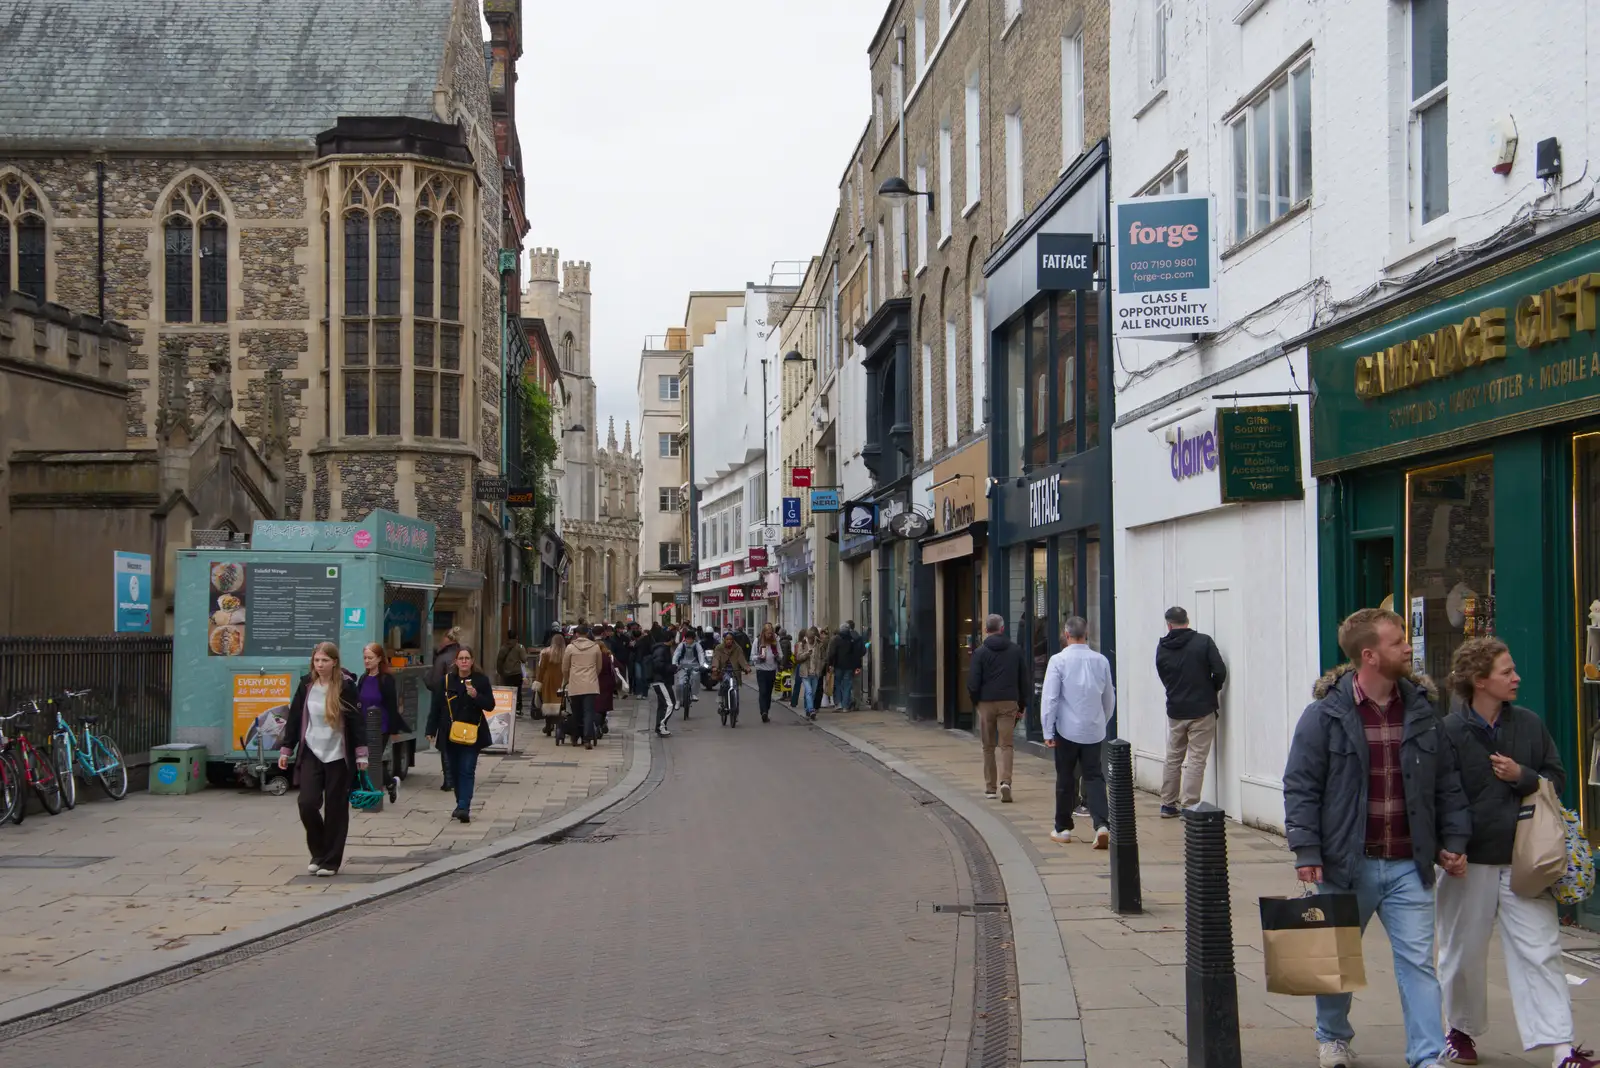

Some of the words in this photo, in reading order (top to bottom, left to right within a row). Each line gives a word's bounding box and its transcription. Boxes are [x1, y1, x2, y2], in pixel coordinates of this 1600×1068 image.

[1129, 221, 1198, 248] forge
[1042, 254, 1088, 269] FATFACE
[1130, 261, 1149, 271] 020
[1150, 259, 1172, 270] 7190
[1174, 258, 1197, 268] 9801
[1133, 271, 1195, 283] forge-cp.com
[1141, 294, 1178, 305] CLASS
[1181, 292, 1188, 302] E
[1119, 303, 1208, 318] OPPORTUNITY
[1121, 319, 1142, 330] ALL
[1144, 315, 1210, 330] ENQUIRIES
[1354, 307, 1507, 399] CAMBRIDGE
[1514, 272, 1600, 349] GIFT
[1483, 373, 1523, 404] POTTER
[1540, 355, 1587, 391] MOBILE
[1246, 416, 1269, 426] Gifts
[1230, 441, 1256, 451] Harry
[1259, 440, 1288, 449] Potter
[1244, 456, 1276, 466] Mobile
[1231, 464, 1290, 475] Accessories
[1249, 481, 1274, 492] Vape
[788, 500, 795, 509] T
[1029, 473, 1060, 528] FATFACE
[788, 509, 796, 519] G
[256, 523, 318, 540] FALAFEL
[237, 678, 262, 686] EVERY
[263, 678, 279, 686] DAY
[279, 678, 287, 686] IS
